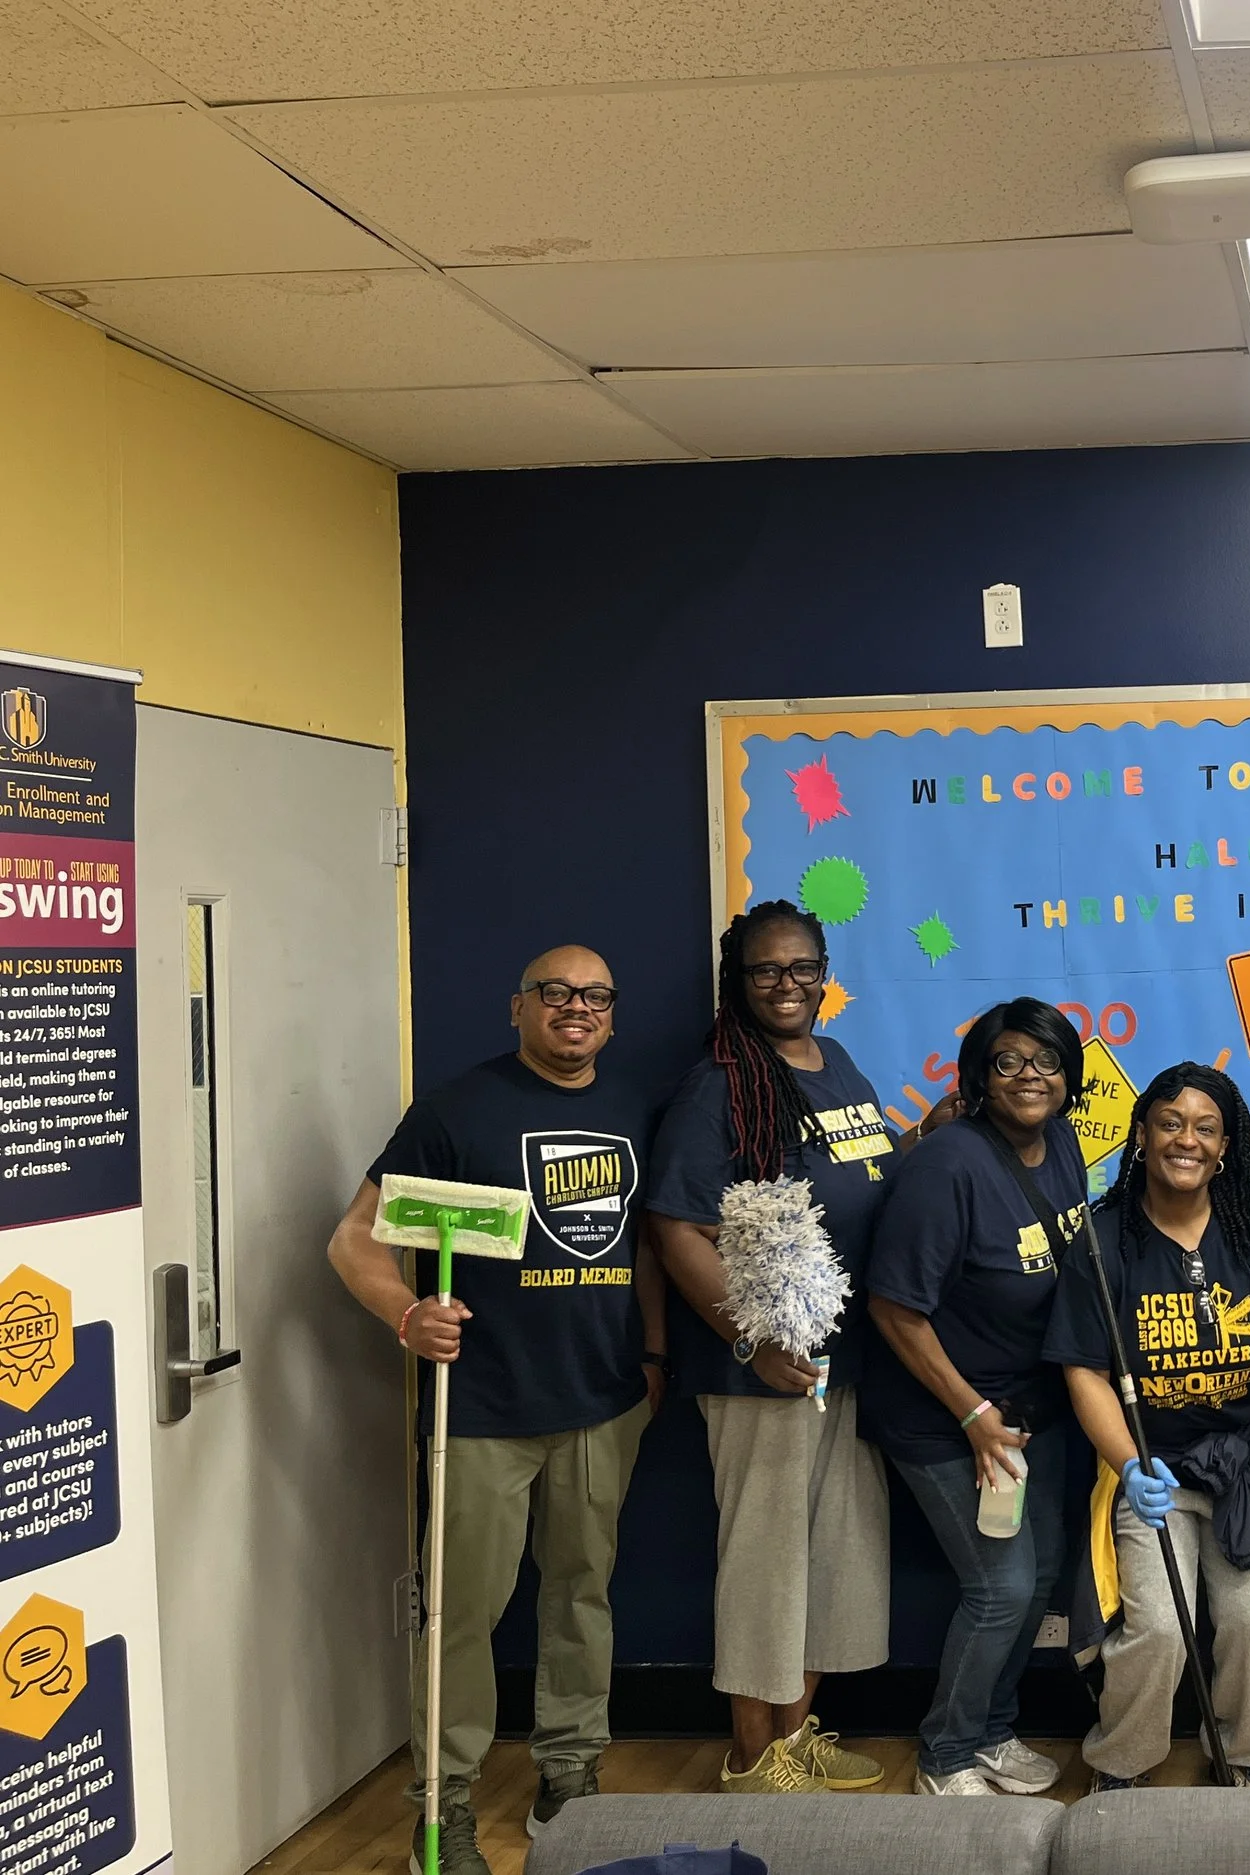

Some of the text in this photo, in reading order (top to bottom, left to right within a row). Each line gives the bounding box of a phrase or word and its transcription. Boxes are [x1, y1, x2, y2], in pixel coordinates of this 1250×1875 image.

[11, 748, 43, 765] Smith
[45, 751, 97, 773] University
[7, 781, 110, 808] Enrollment and
[911, 766, 1144, 805] WELCOME
[19, 801, 106, 825] Management
[14, 858, 42, 880] TODAY
[44, 859, 54, 881] TO
[70, 861, 95, 882] START
[96, 863, 120, 884] USING
[0, 870, 124, 935] swing
[1013, 894, 1195, 929] THRIVE
[0, 958, 123, 979] N JCSU STUDENTS
[11, 986, 29, 997] an
[31, 983, 69, 997] online
[71, 982, 116, 998] tutoring
[7, 1005, 66, 1020] available
[69, 1005, 81, 1017] to
[82, 1003, 111, 1021] JCSU
[13, 1028, 47, 1043] 24/7,
[49, 1026, 76, 1040] 365!
[78, 1025, 106, 1039] Most
[16, 1048, 69, 1064] terminal
[72, 1047, 117, 1064] degrees
[29, 1070, 76, 1087] making
[78, 1068, 107, 1083] them
[109, 1069, 116, 1080] a
[45, 1092, 96, 1107] resource
[98, 1088, 114, 1102] for
[0, 1108, 129, 1135] oking to improve their
[4, 1131, 125, 1157] standing in a variety
[547, 1148, 556, 1156] 18
[4, 1161, 71, 1179] of classes.
[544, 1153, 621, 1196] ALUMNI
[546, 1184, 619, 1206] CHARLOTTE CHAPTER
[559, 1225, 588, 1234] JOHNSON
[571, 1234, 607, 1242] UNIVERSITY
[520, 1268, 575, 1287] BOARD
[1136, 1292, 1194, 1321] JCSU
[1147, 1318, 1198, 1350] 2000
[6, 1426, 42, 1450] with
[46, 1415, 92, 1439] tutors
[3, 1429, 109, 1474] every subject
[5, 1459, 95, 1496] and course
[32, 1492, 50, 1511] at
[52, 1477, 92, 1510] JCSU
[15, 1499, 93, 1539] subjects)!
[0, 1729, 102, 1791] ceive helpful
[67, 1755, 104, 1782] from
[14, 1816, 25, 1831] a
[28, 1784, 81, 1823] virtual
[83, 1770, 114, 1797] text
[1, 1807, 89, 1860] messaging
[51, 1829, 86, 1857] with
[89, 1816, 116, 1839] live
